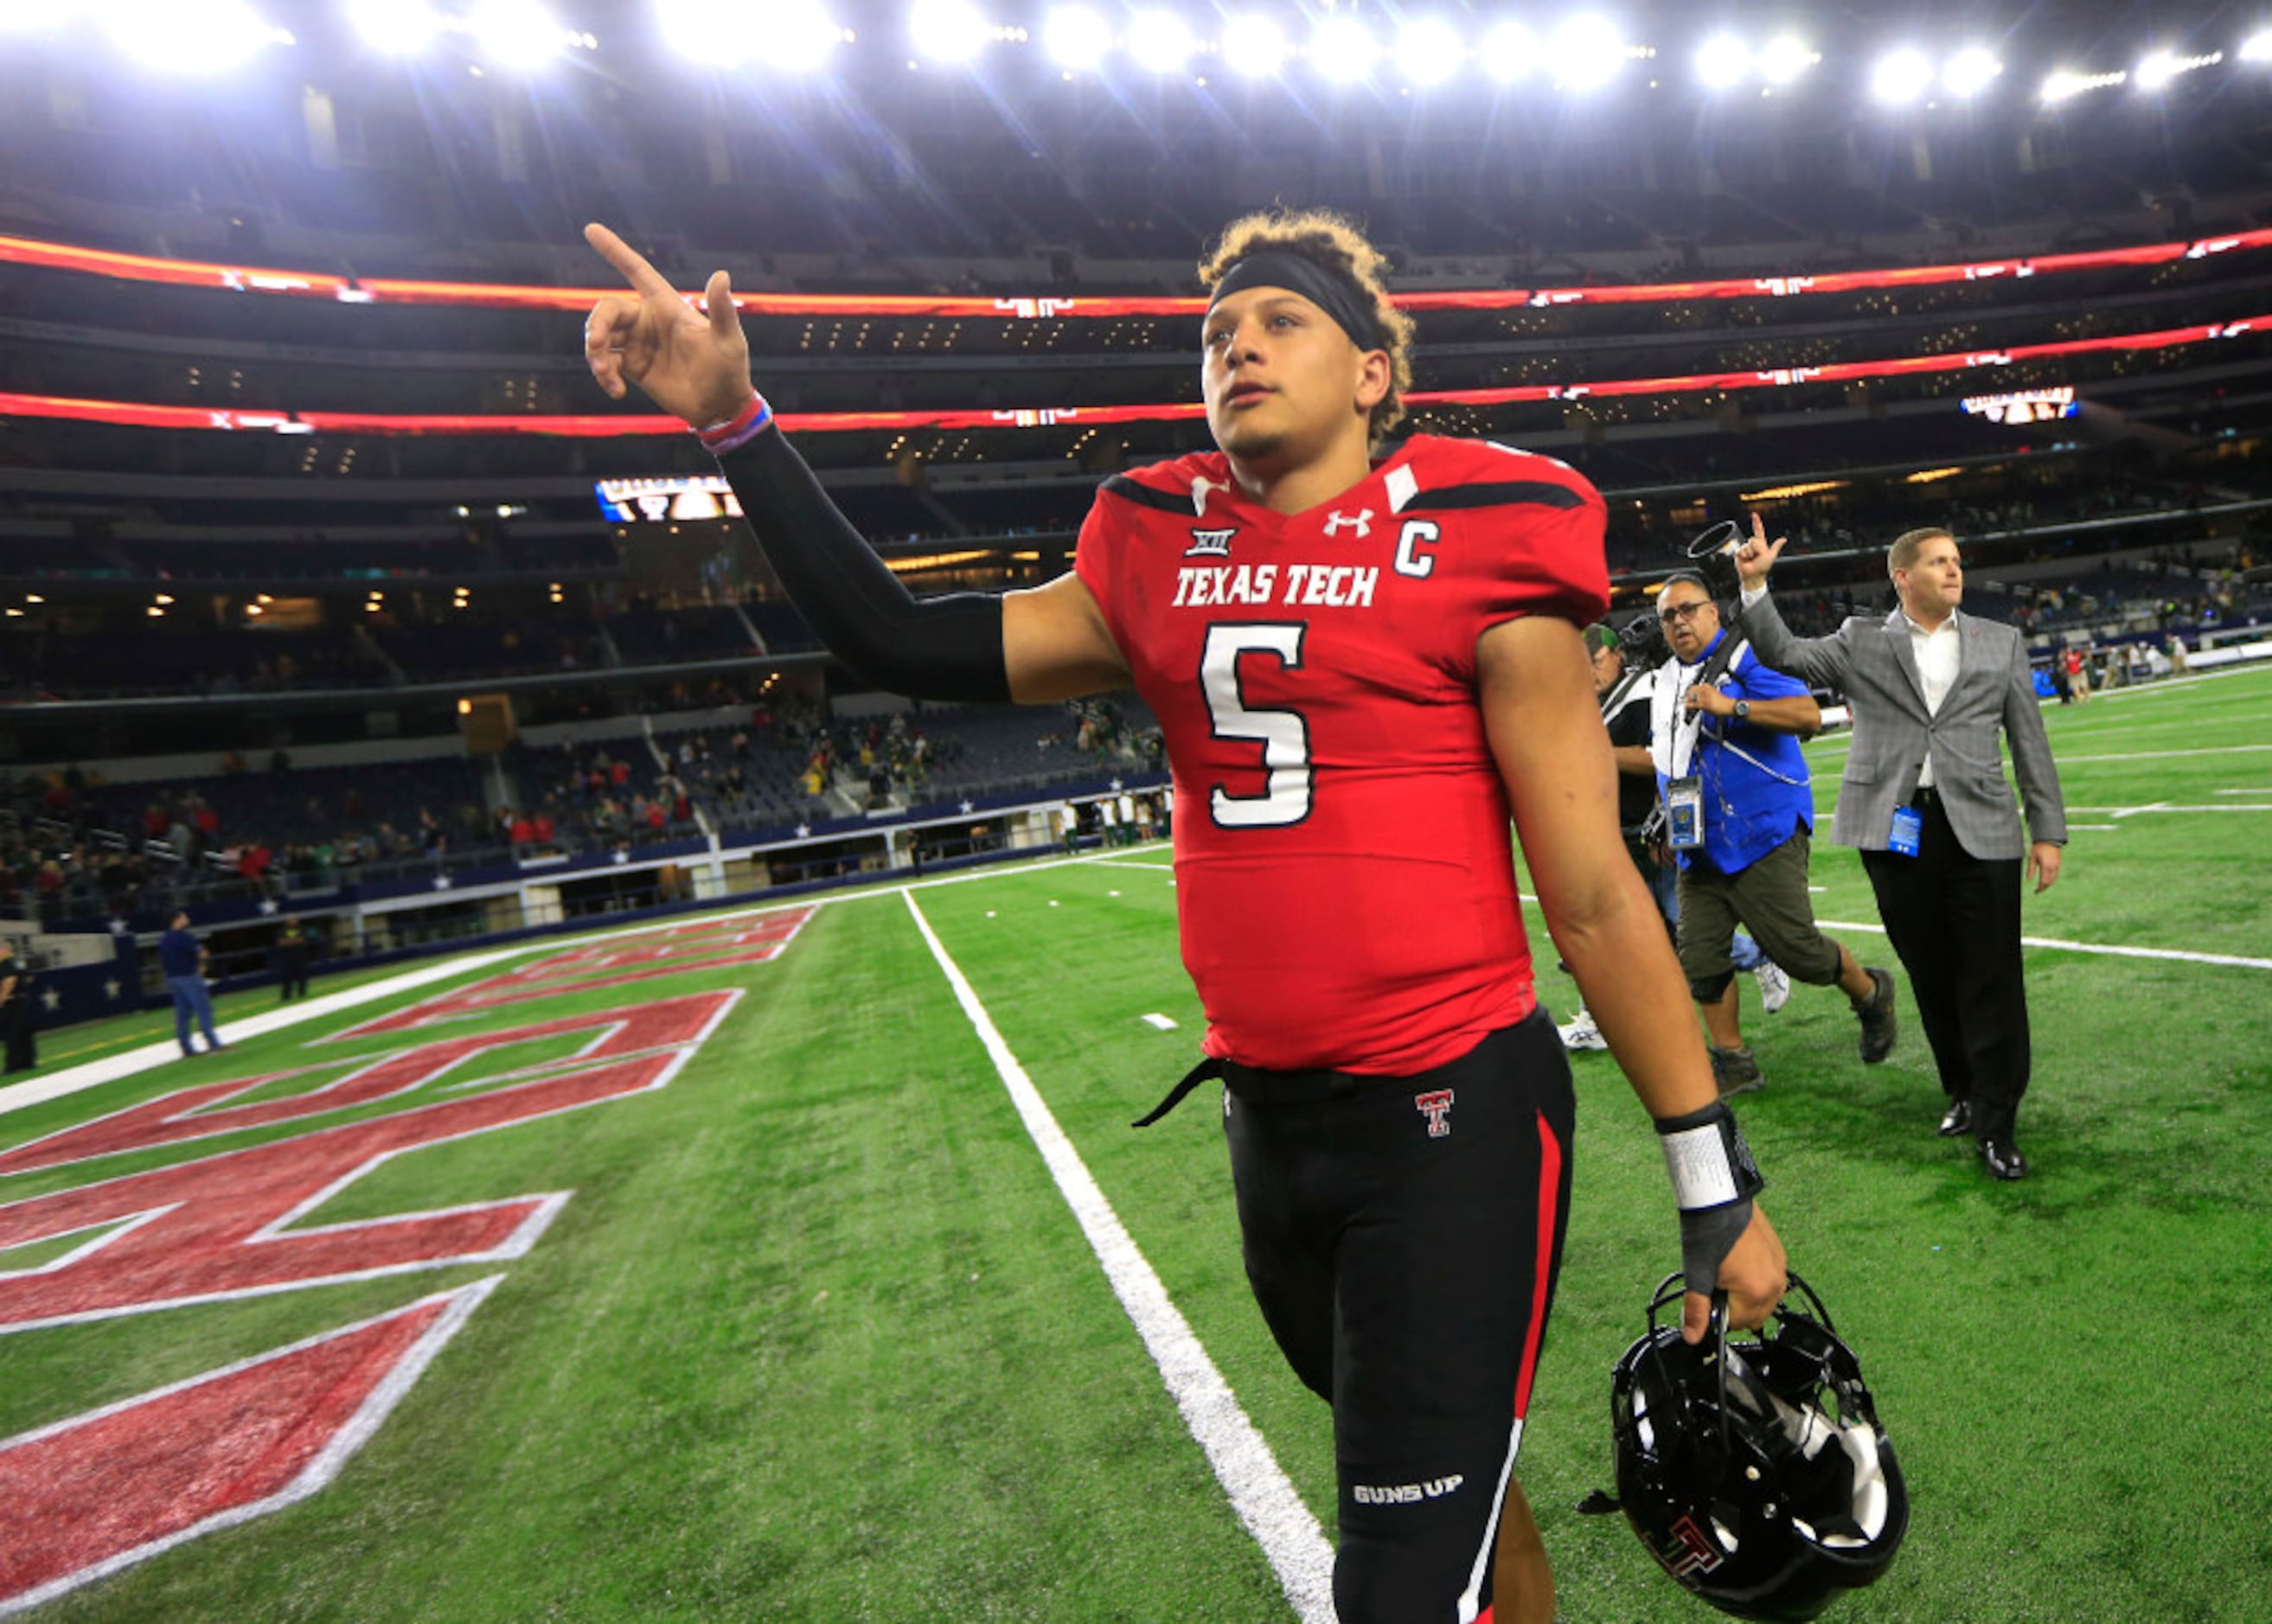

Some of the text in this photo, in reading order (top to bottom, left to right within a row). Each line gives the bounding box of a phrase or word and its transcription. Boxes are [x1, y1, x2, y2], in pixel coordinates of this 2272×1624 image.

[1393, 518, 1440, 580] C
[1172, 565, 1379, 607] TEXAS TECH
[1198, 619, 1316, 830] 5
[1354, 1474, 1463, 1503] GUNS UP
